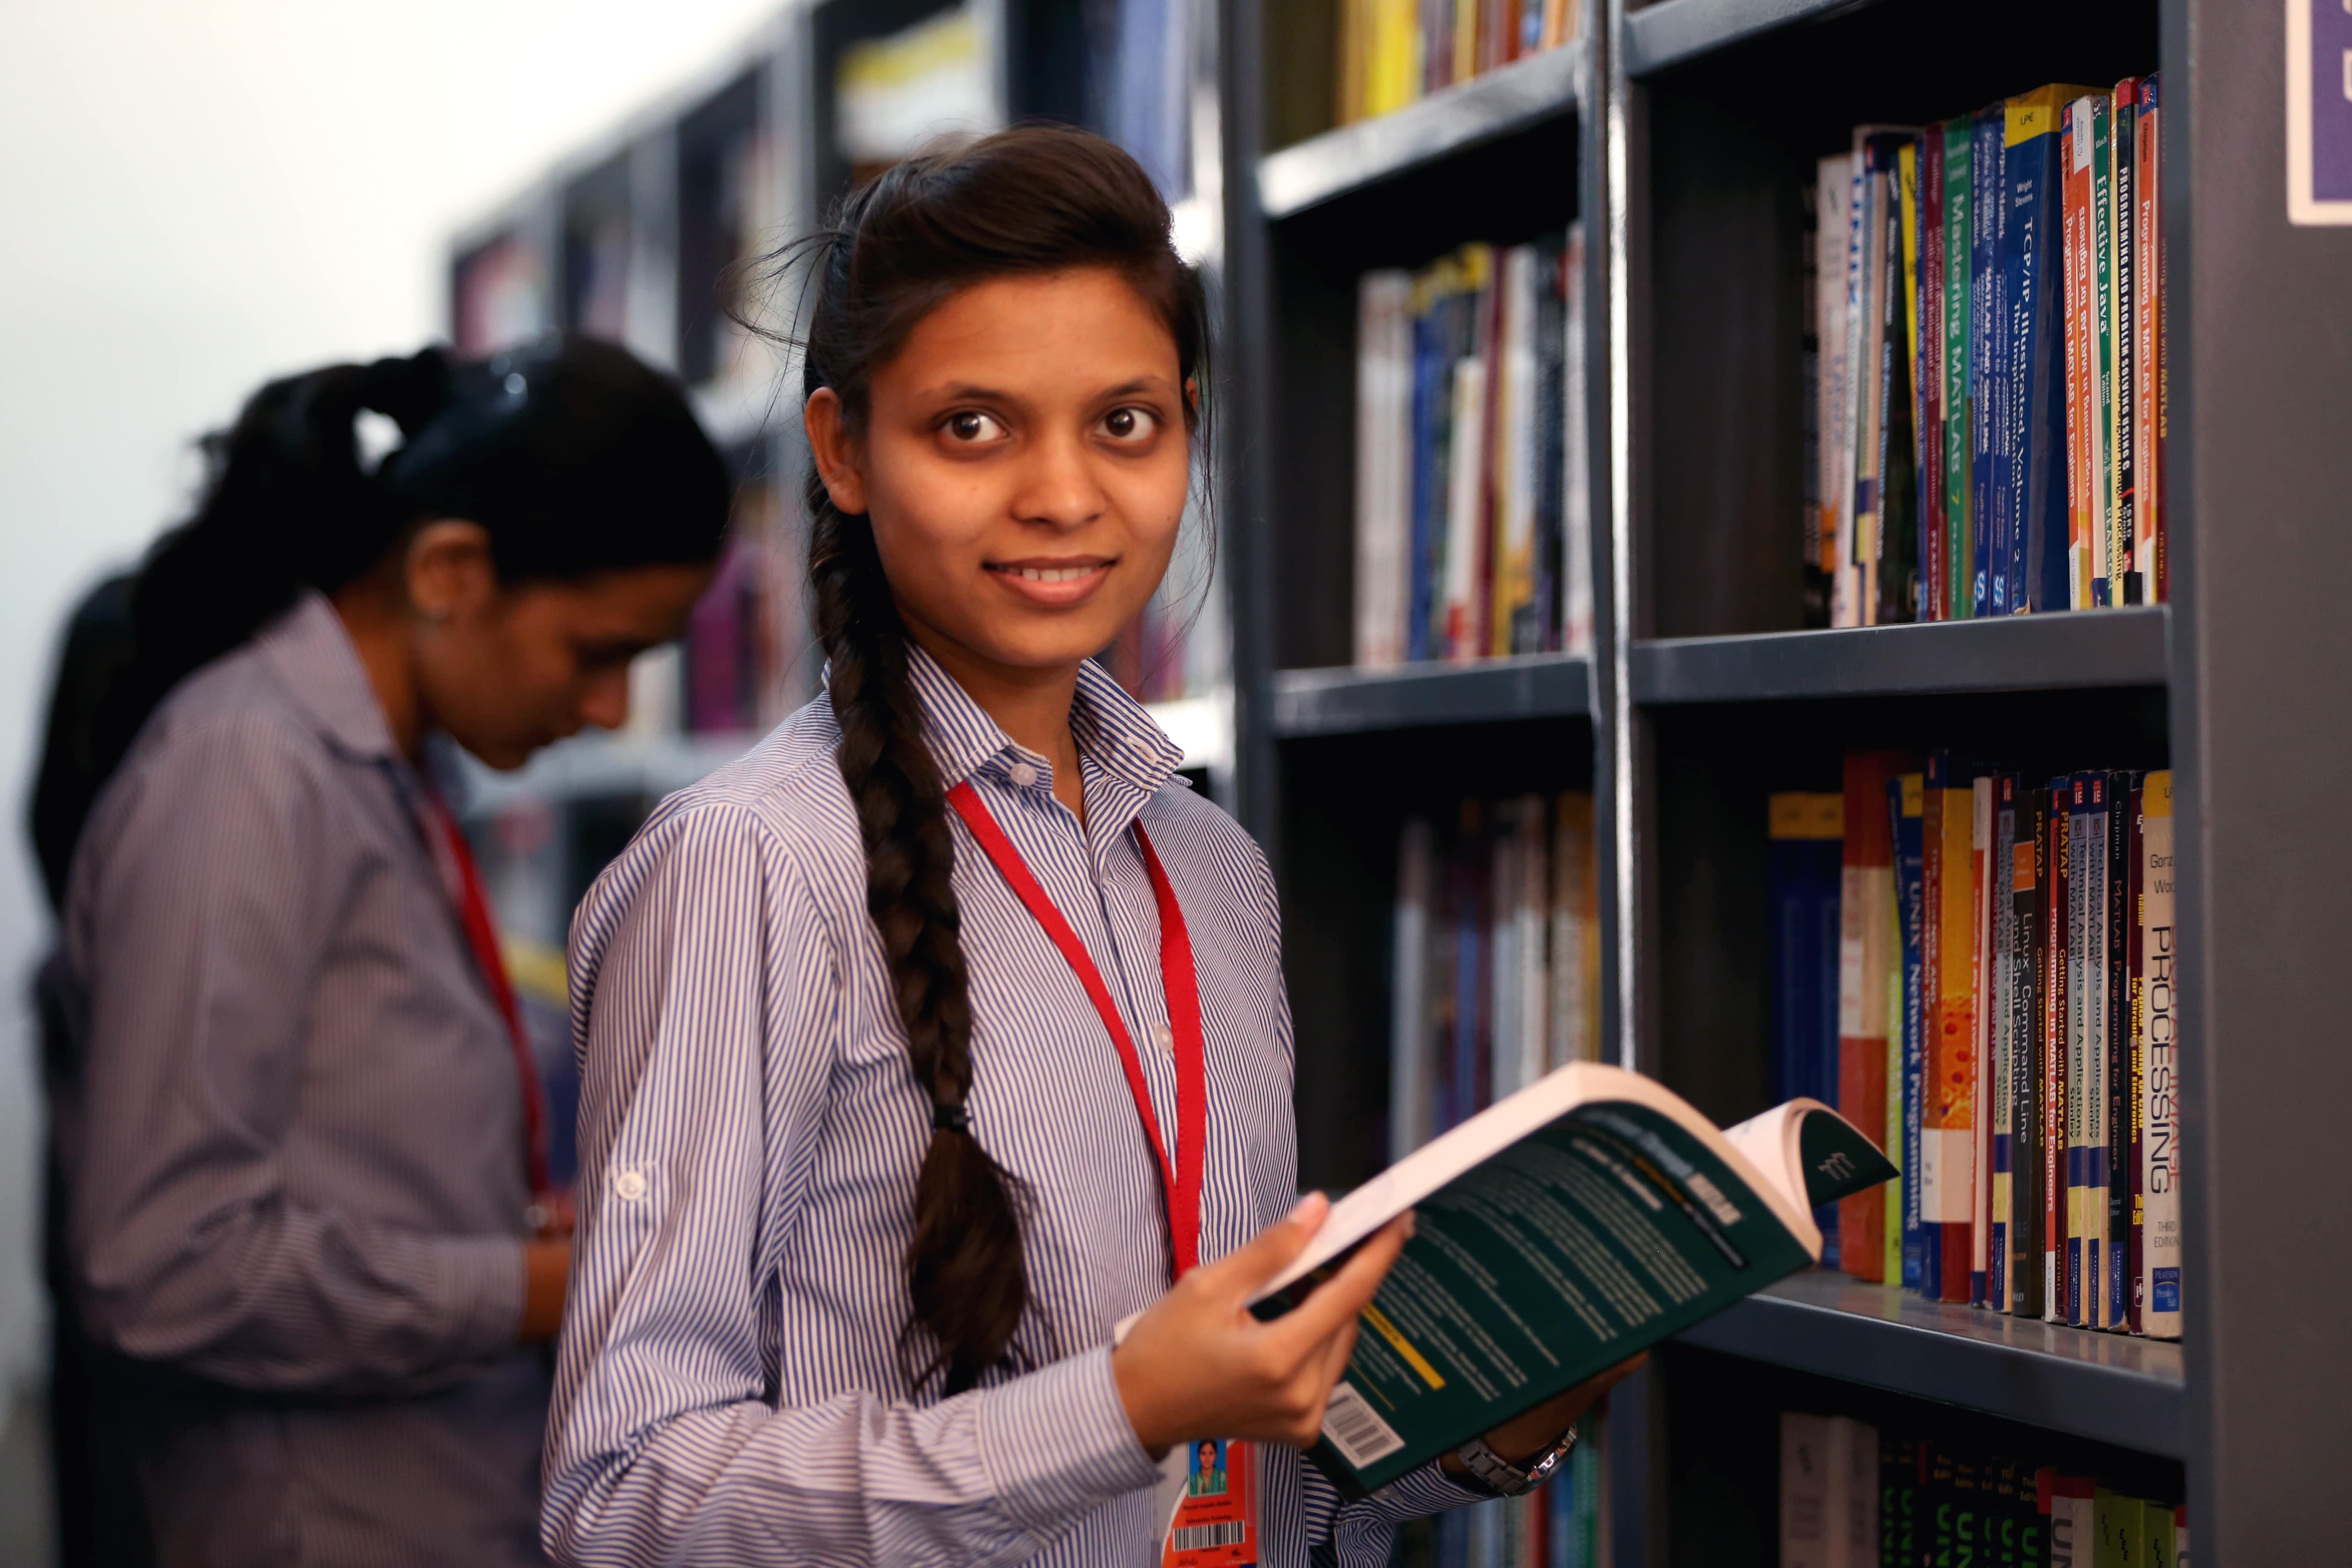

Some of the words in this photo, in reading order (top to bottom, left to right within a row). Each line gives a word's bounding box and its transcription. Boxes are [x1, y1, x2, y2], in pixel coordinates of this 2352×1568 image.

[2020, 112, 2034, 126] LPE
[2095, 135, 2107, 149] Bloch
[2015, 193, 2033, 208] Stevens
[2016, 178, 2033, 194] Wright
[2119, 166, 2128, 265] PROGRAMMING
[2096, 175, 2107, 274] Effective
[2141, 200, 2150, 305] Programming
[1950, 193, 1965, 339] Mastering
[2021, 216, 2033, 303] TCP/IP
[2120, 267, 2128, 294] AND
[2067, 322, 2074, 338] in
[2121, 296, 2129, 356] PROBLEM
[2142, 308, 2150, 325] in
[1951, 345, 1962, 473] MATLAB
[2017, 311, 2030, 442] Illustrated,
[2121, 358, 2129, 414] SOLVING
[2011, 340, 2019, 489] Implementation
[2122, 416, 2130, 458] USING
[1951, 489, 1960, 505] 7
[2014, 447, 2024, 540] Volume
[2122, 460, 2130, 471] C
[2142, 425, 2150, 502] Engineers
[2014, 548, 2020, 564] 2
[2060, 811, 2069, 879] PRATAP
[2114, 801, 2122, 859] Chapman
[2077, 842, 2086, 916] Technical
[2096, 840, 2104, 916] Technical
[1909, 881, 1921, 948] UNIX
[2012, 914, 2021, 952] and
[2023, 912, 2033, 970] Linux
[2005, 918, 2013, 983] Analysis
[2012, 959, 2021, 1009] Shell
[2058, 949, 2066, 996] Getting
[2076, 923, 2085, 990] Analysis
[2095, 922, 2104, 990] Analysis
[1909, 964, 1921, 1067] Network
[2021, 984, 2031, 1093] Command
[2049, 1018, 2057, 1032] in
[2111, 960, 2122, 1065] Programming
[2001, 1025, 2010, 1126] Applications
[2012, 1015, 2021, 1107] Scripting
[2074, 1033, 2084, 1138] Applications
[2093, 1033, 2102, 1138] Applications
[2113, 1068, 2121, 1090] for
[2150, 926, 2171, 1194] PROCESSING
[1906, 1073, 1921, 1231] Programming
[2020, 1099, 2030, 1144] Line
[2111, 1096, 2121, 1170] Engineers
[2046, 1136, 2056, 1212] Engineers
[2154, 1270, 2178, 1279] PEARSON
